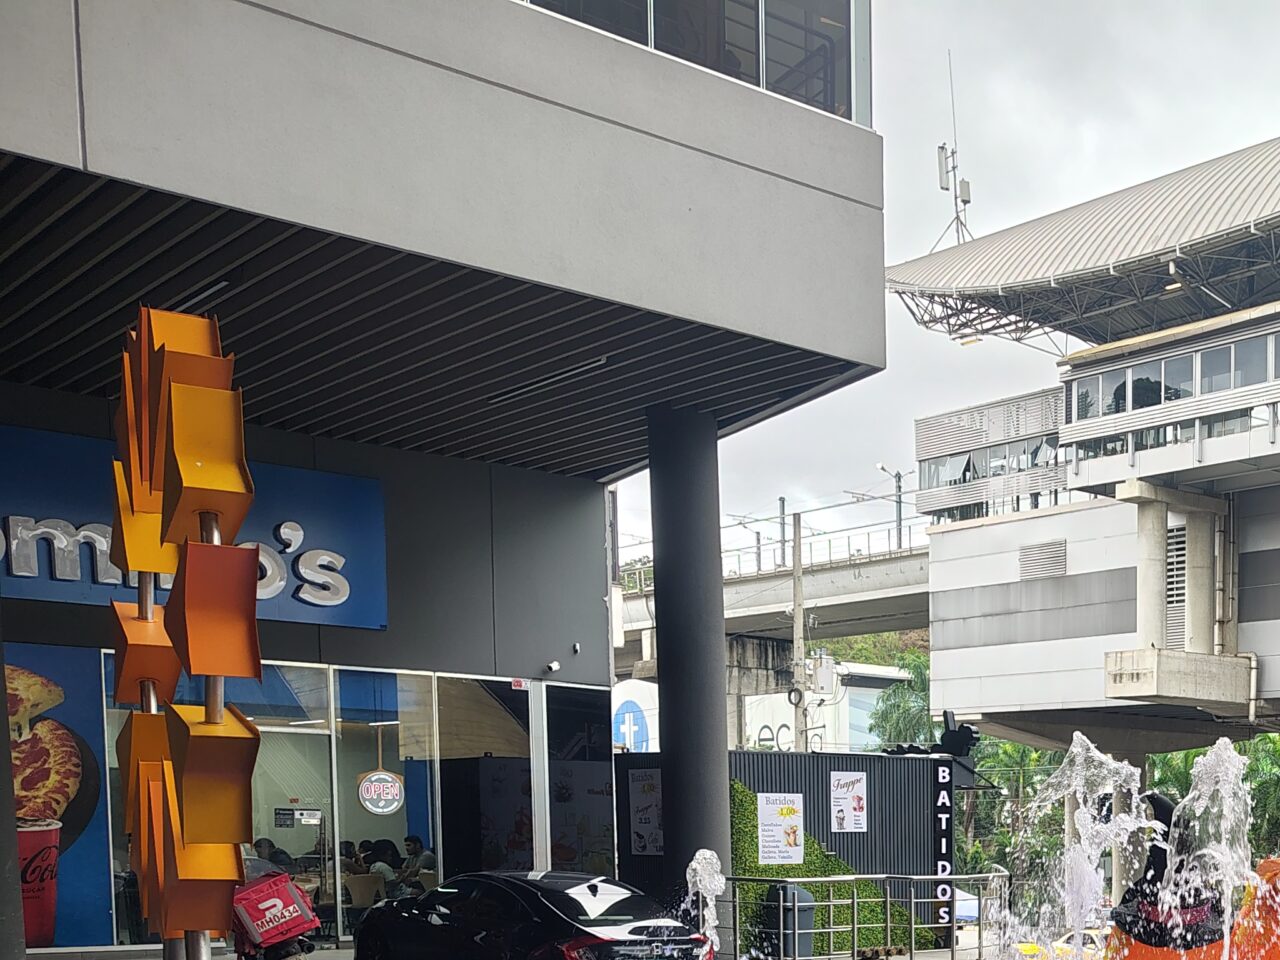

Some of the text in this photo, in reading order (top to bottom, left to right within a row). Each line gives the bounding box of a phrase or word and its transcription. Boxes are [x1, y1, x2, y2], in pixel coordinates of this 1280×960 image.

[362, 782, 400, 800] OPEN
[765, 796, 796, 806] Batidos
[936, 766, 952, 924] BATIDOS
[255, 905, 300, 932] MH0434
